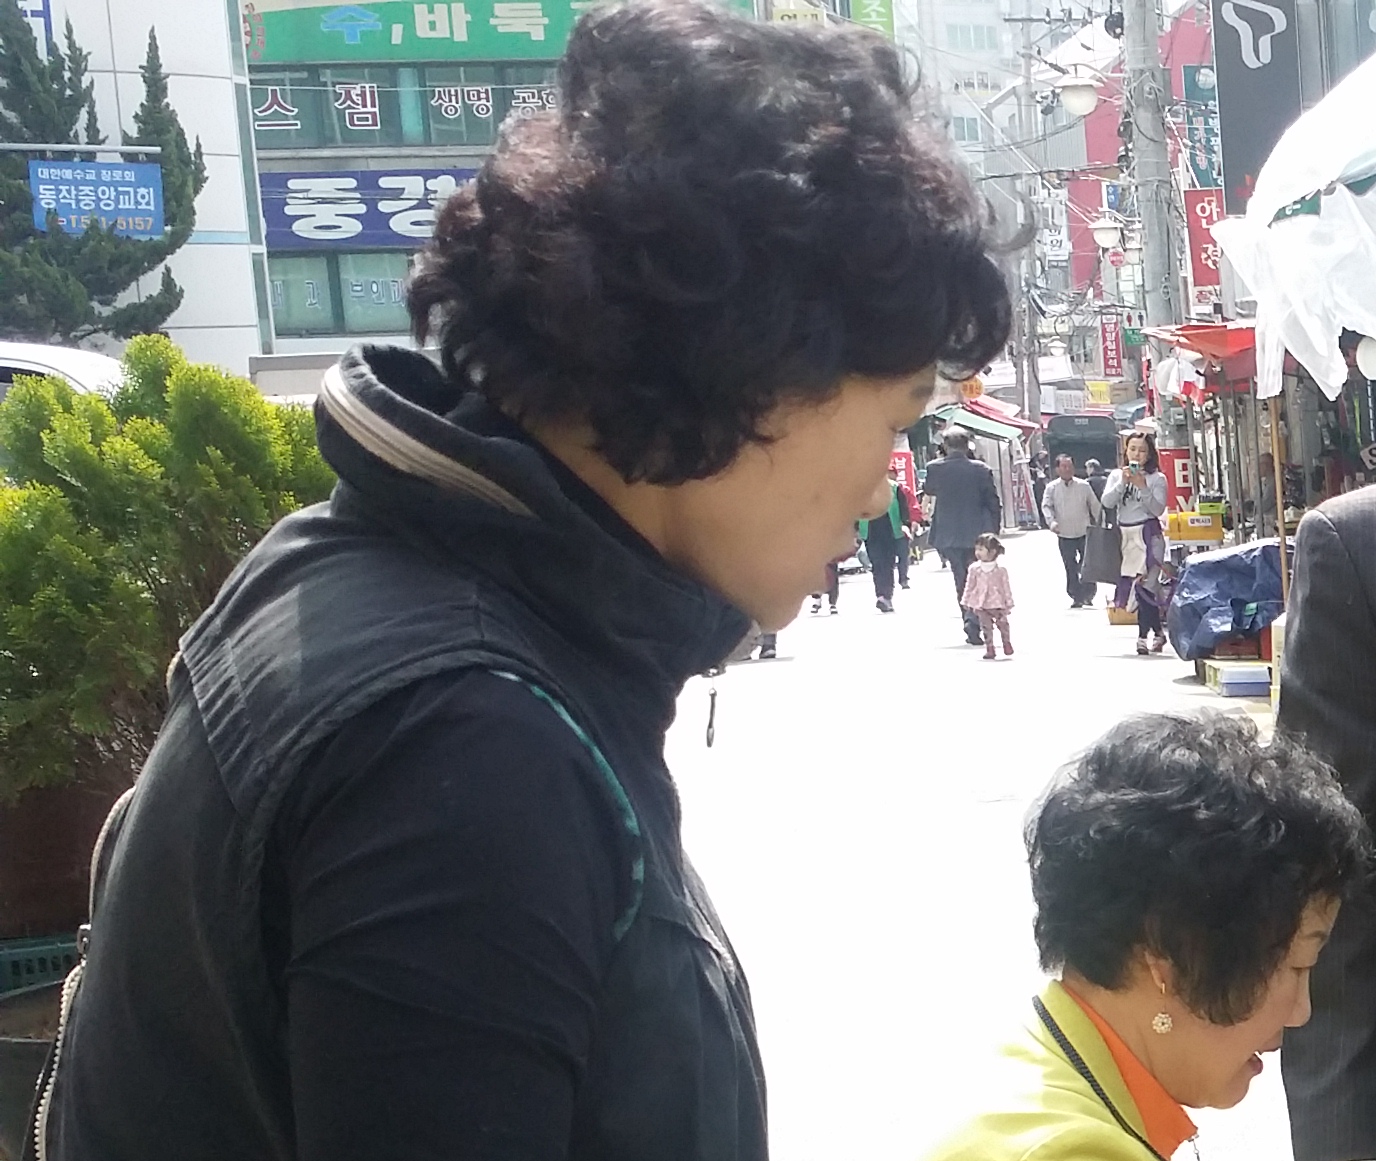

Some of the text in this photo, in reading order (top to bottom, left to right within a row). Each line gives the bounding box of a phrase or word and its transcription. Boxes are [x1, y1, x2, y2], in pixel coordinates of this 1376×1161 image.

[37, 168, 136, 182] 대한예수교 장로회
[38, 184, 155, 211] 동작중앙교회
[69, 214, 154, 231] T.51-5157
